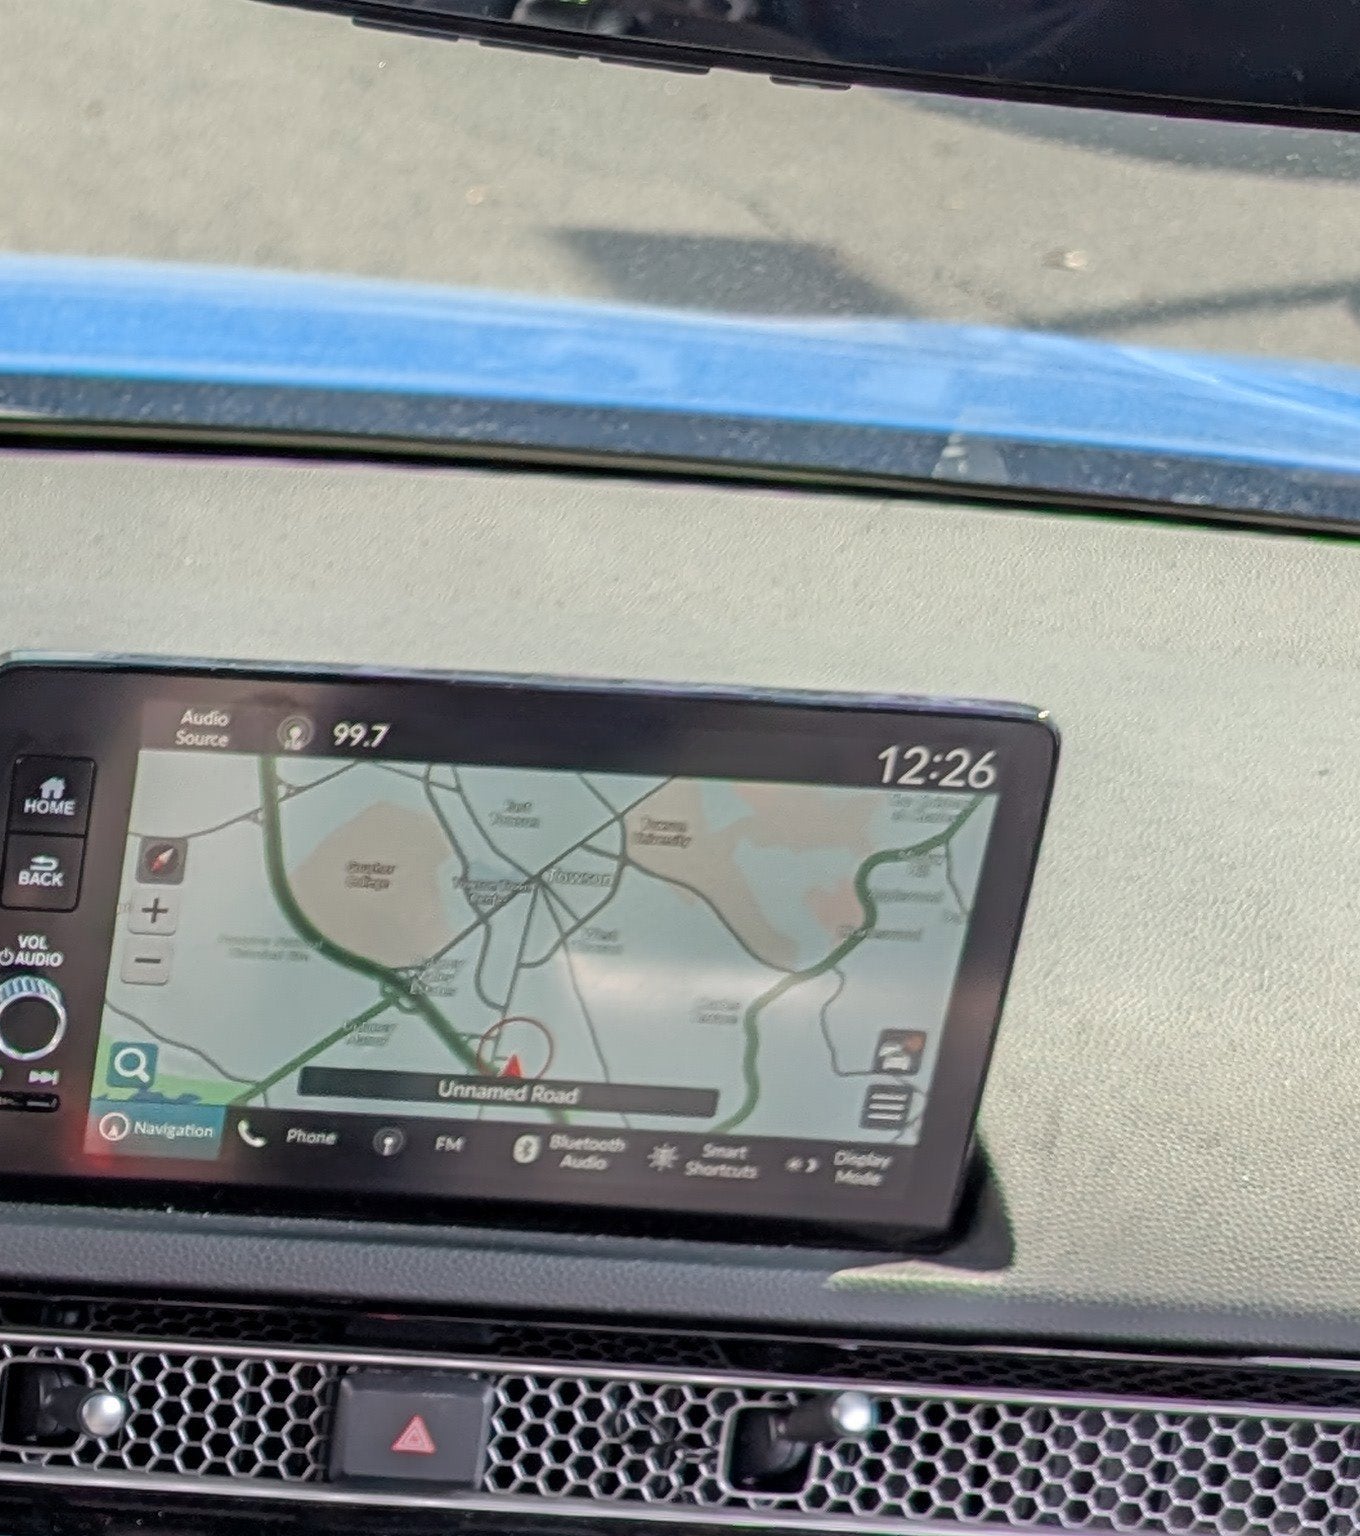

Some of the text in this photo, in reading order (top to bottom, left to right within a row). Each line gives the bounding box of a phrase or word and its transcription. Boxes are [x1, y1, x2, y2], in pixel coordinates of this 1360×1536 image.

[181, 709, 229, 727] Audio
[175, 730, 229, 748] Source
[332, 723, 390, 748] 99.7
[877, 745, 998, 789] 12:26
[24, 799, 75, 816] HOME
[18, 871, 63, 887] BACK
[18, 935, 47, 950] VOL
[14, 953, 63, 967] AUDIO
[438, 1080, 580, 1103] Unnamed Road
[133, 1121, 213, 1139] Navigation
[286, 1129, 336, 1145] Phone
[435, 1136, 464, 1151] FM
[549, 1134, 625, 1152] Bluetooth
[560, 1153, 608, 1170] Audio
